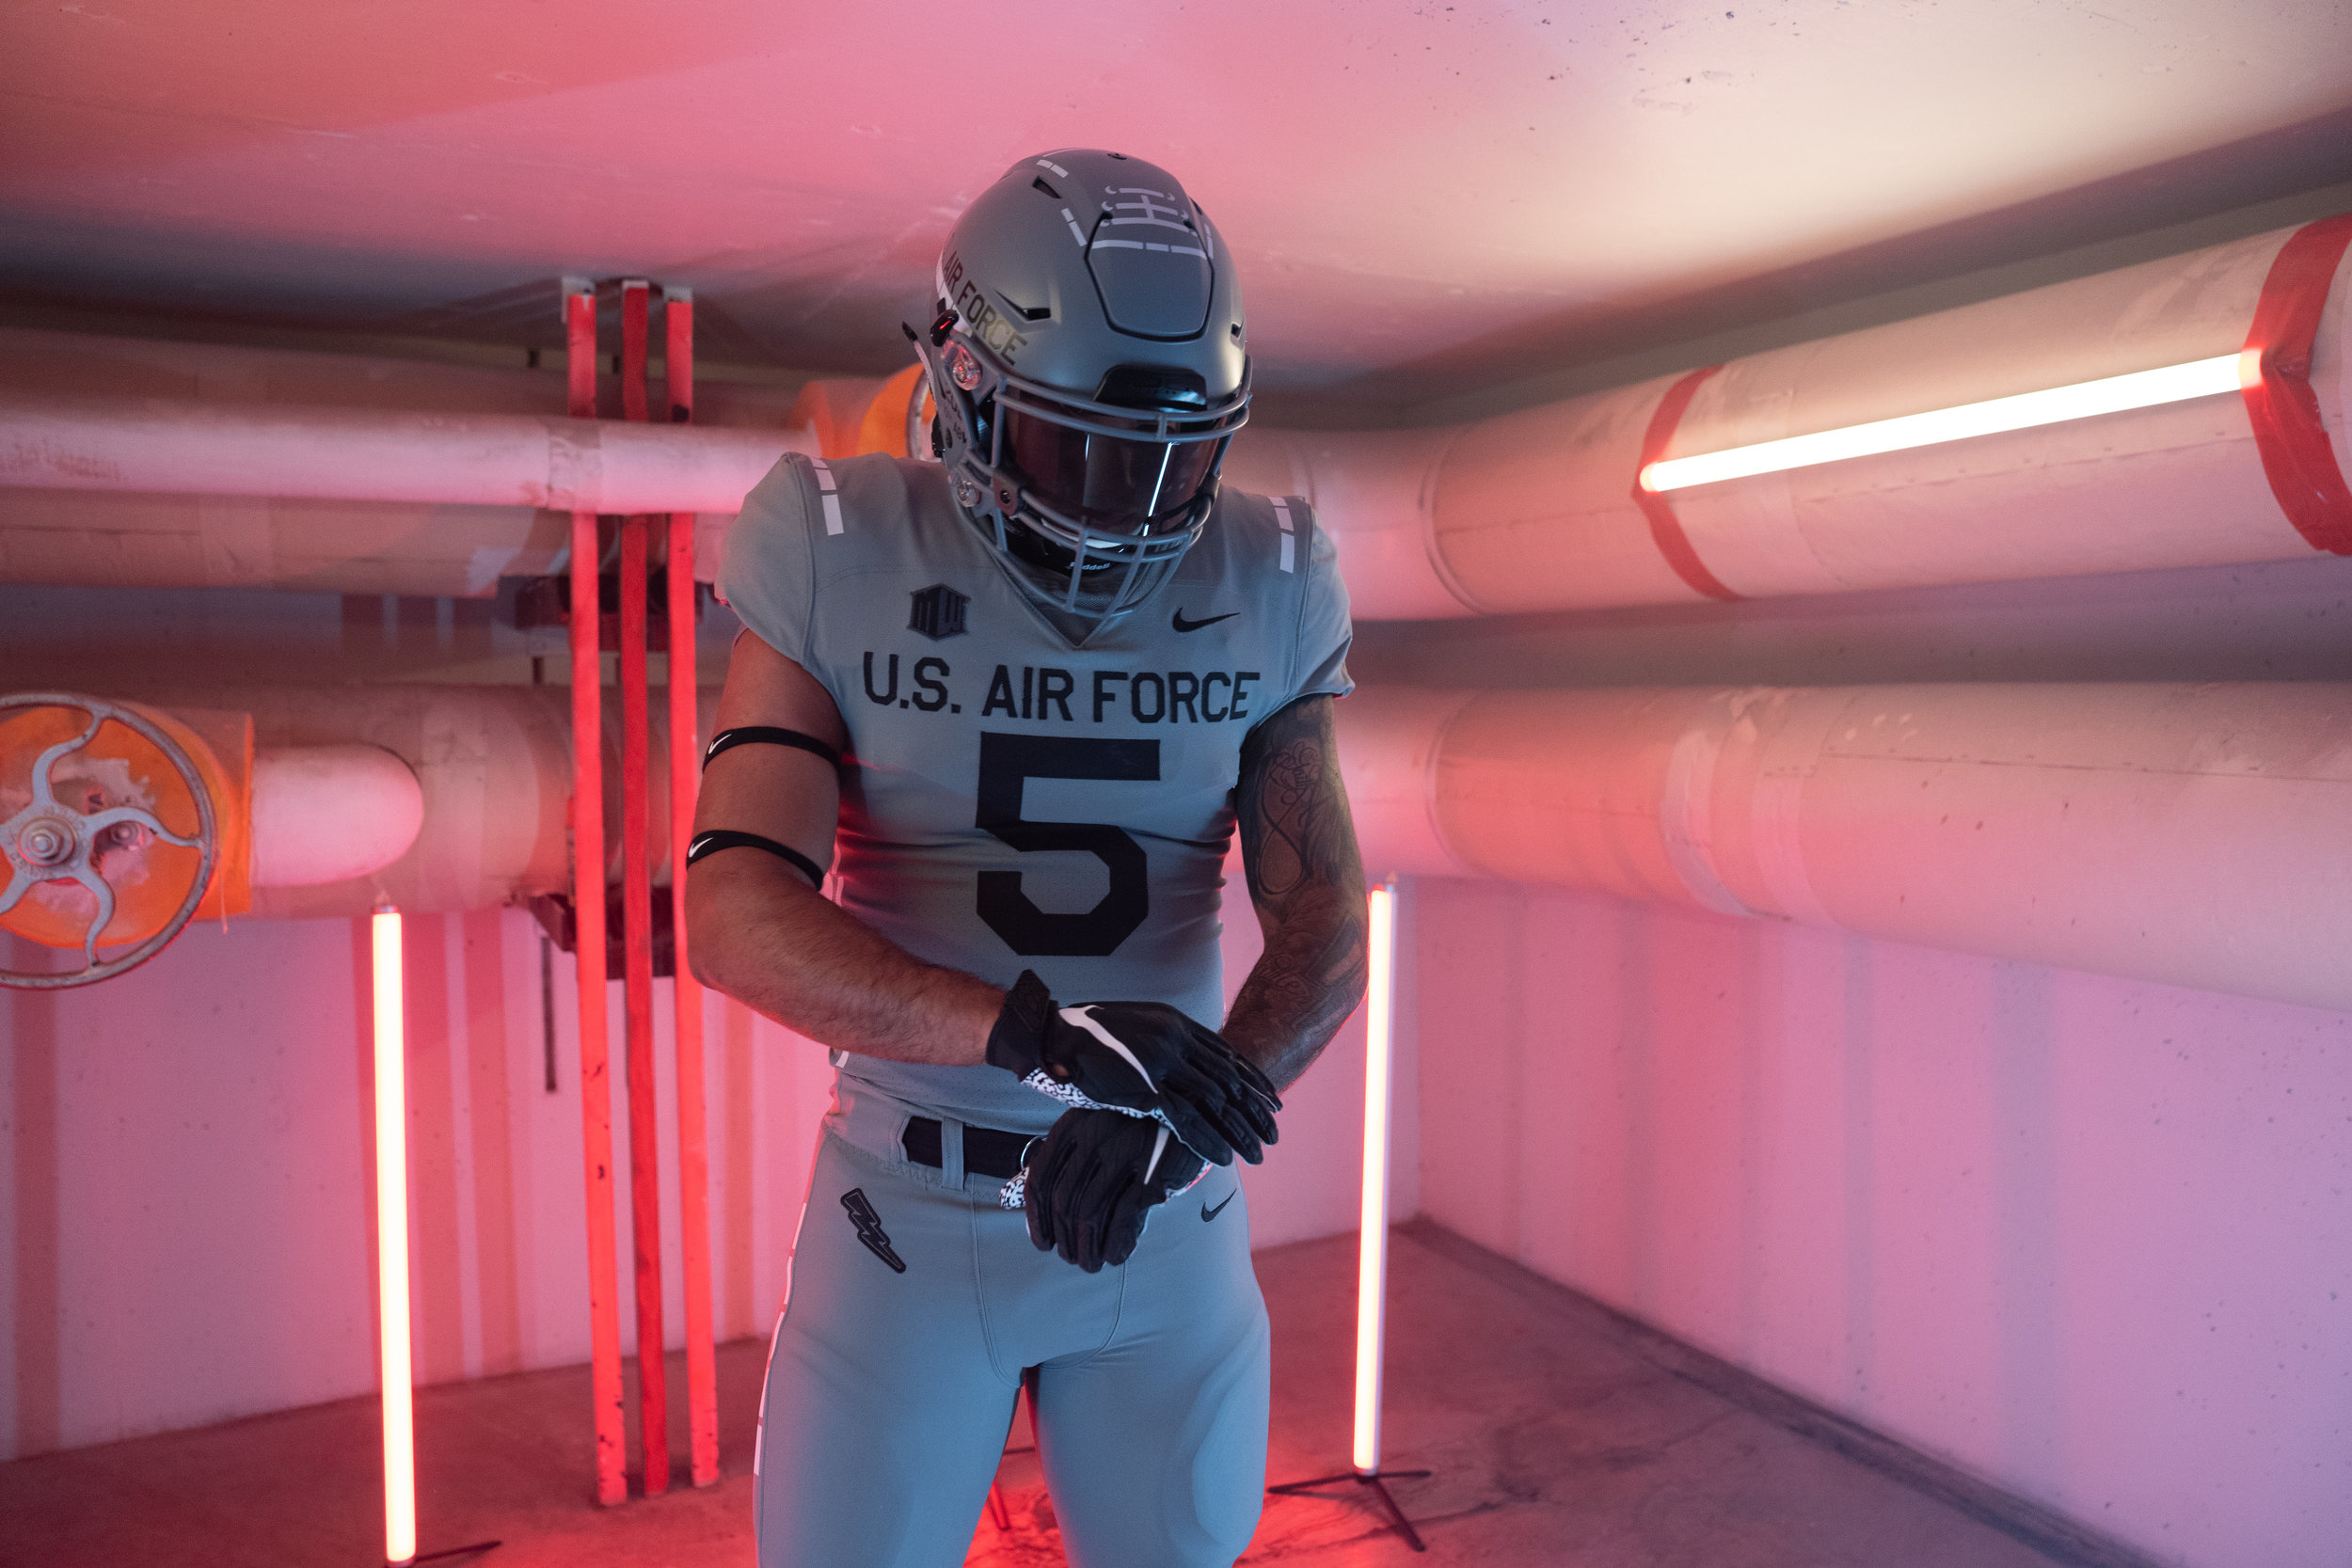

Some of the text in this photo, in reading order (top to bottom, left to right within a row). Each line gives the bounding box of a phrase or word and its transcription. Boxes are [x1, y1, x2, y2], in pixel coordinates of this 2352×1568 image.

[944, 250, 963, 294] AIR
[957, 279, 1027, 366] FORCE
[863, 651, 1261, 724] U.S. AIR FORCE
[976, 731, 1161, 957] 5
